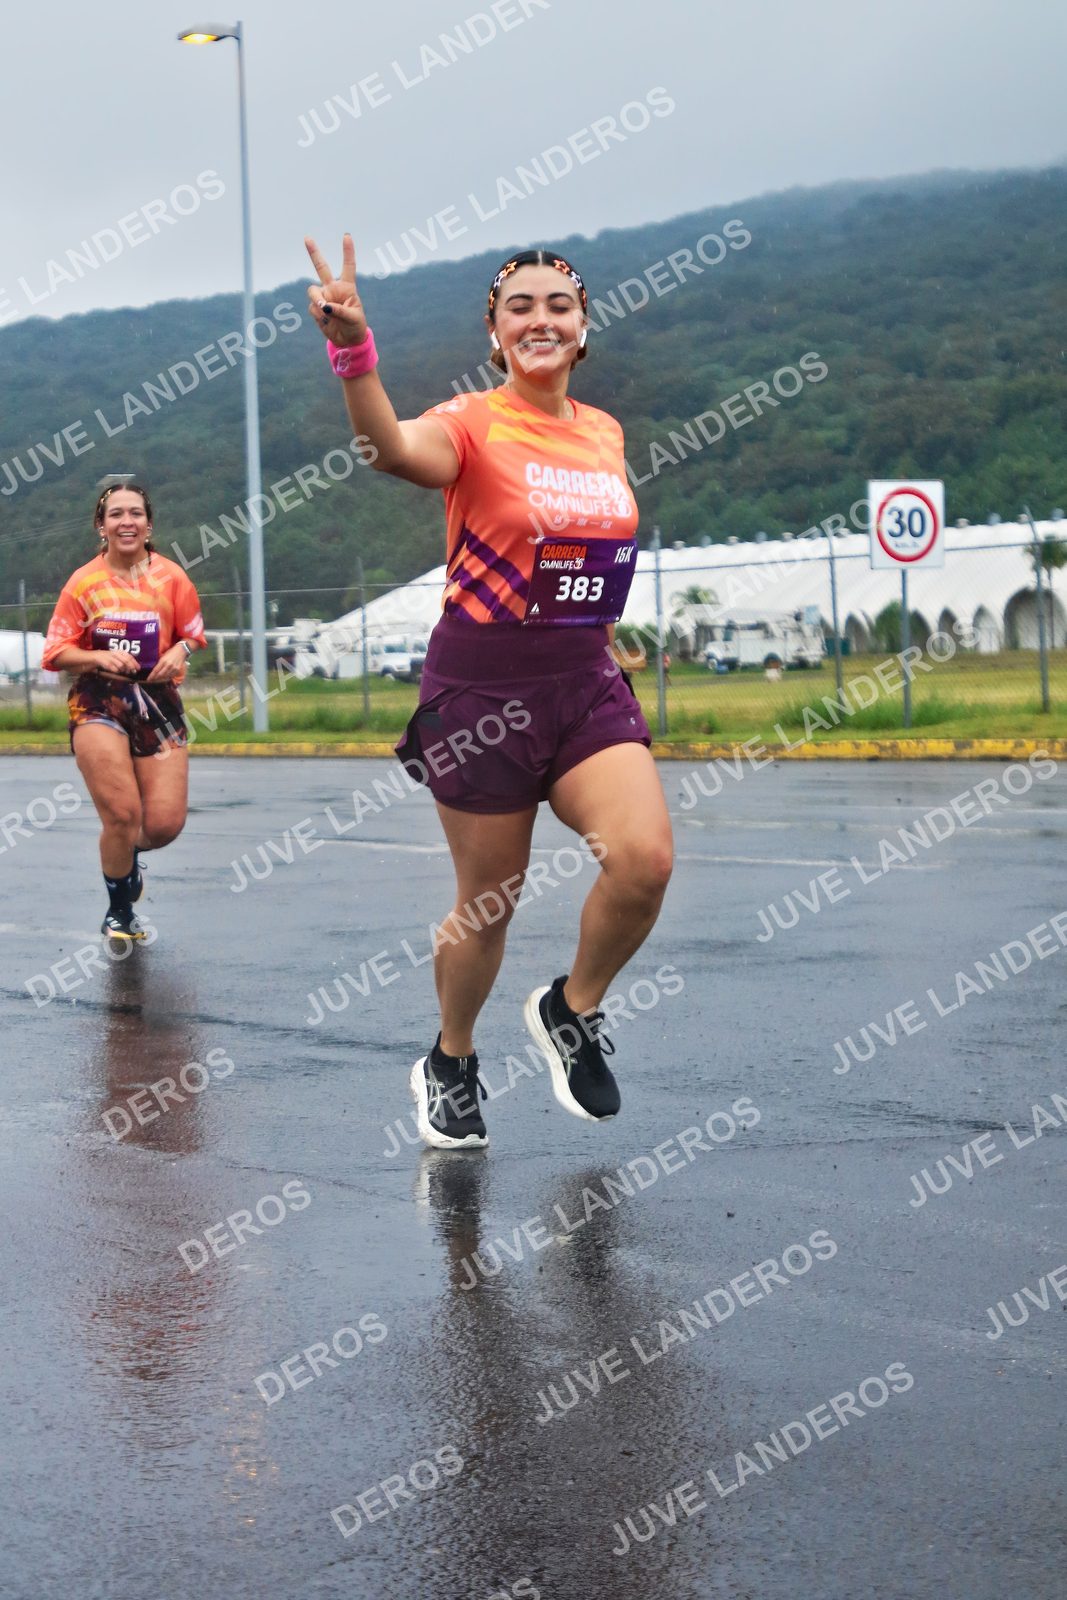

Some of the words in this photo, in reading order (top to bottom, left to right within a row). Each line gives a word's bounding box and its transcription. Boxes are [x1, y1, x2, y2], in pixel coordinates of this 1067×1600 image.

[526, 462, 627, 497] CARRERA
[528, 491, 612, 516] OMNILIFE
[888, 506, 926, 538] 30
[541, 545, 587, 559] CARRERA
[614, 546, 634, 563] 15K
[555, 576, 605, 601] 383
[109, 638, 140, 654] 505
